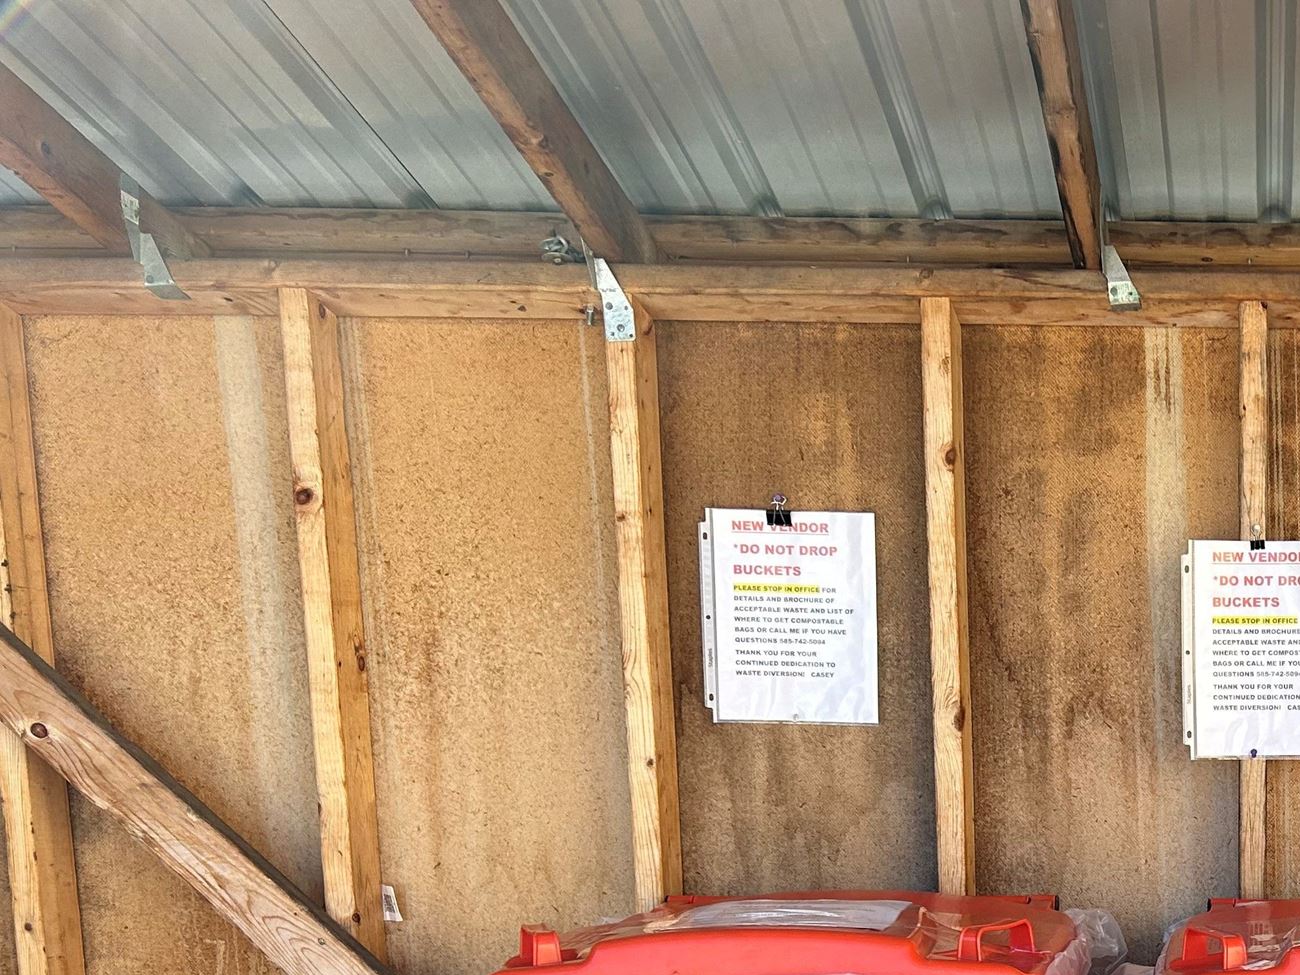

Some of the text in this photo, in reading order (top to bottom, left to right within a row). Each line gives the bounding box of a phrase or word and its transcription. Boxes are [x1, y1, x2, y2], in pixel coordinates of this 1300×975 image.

[732, 521, 828, 533] NEW VENDOR
[766, 545, 794, 555] NOT
[800, 546, 837, 556] DROP
[1213, 552, 1243, 562] NEW
[734, 565, 801, 576] BUCKETS
[1244, 576, 1273, 586] NOT
[1213, 597, 1280, 607] BUCKETS
